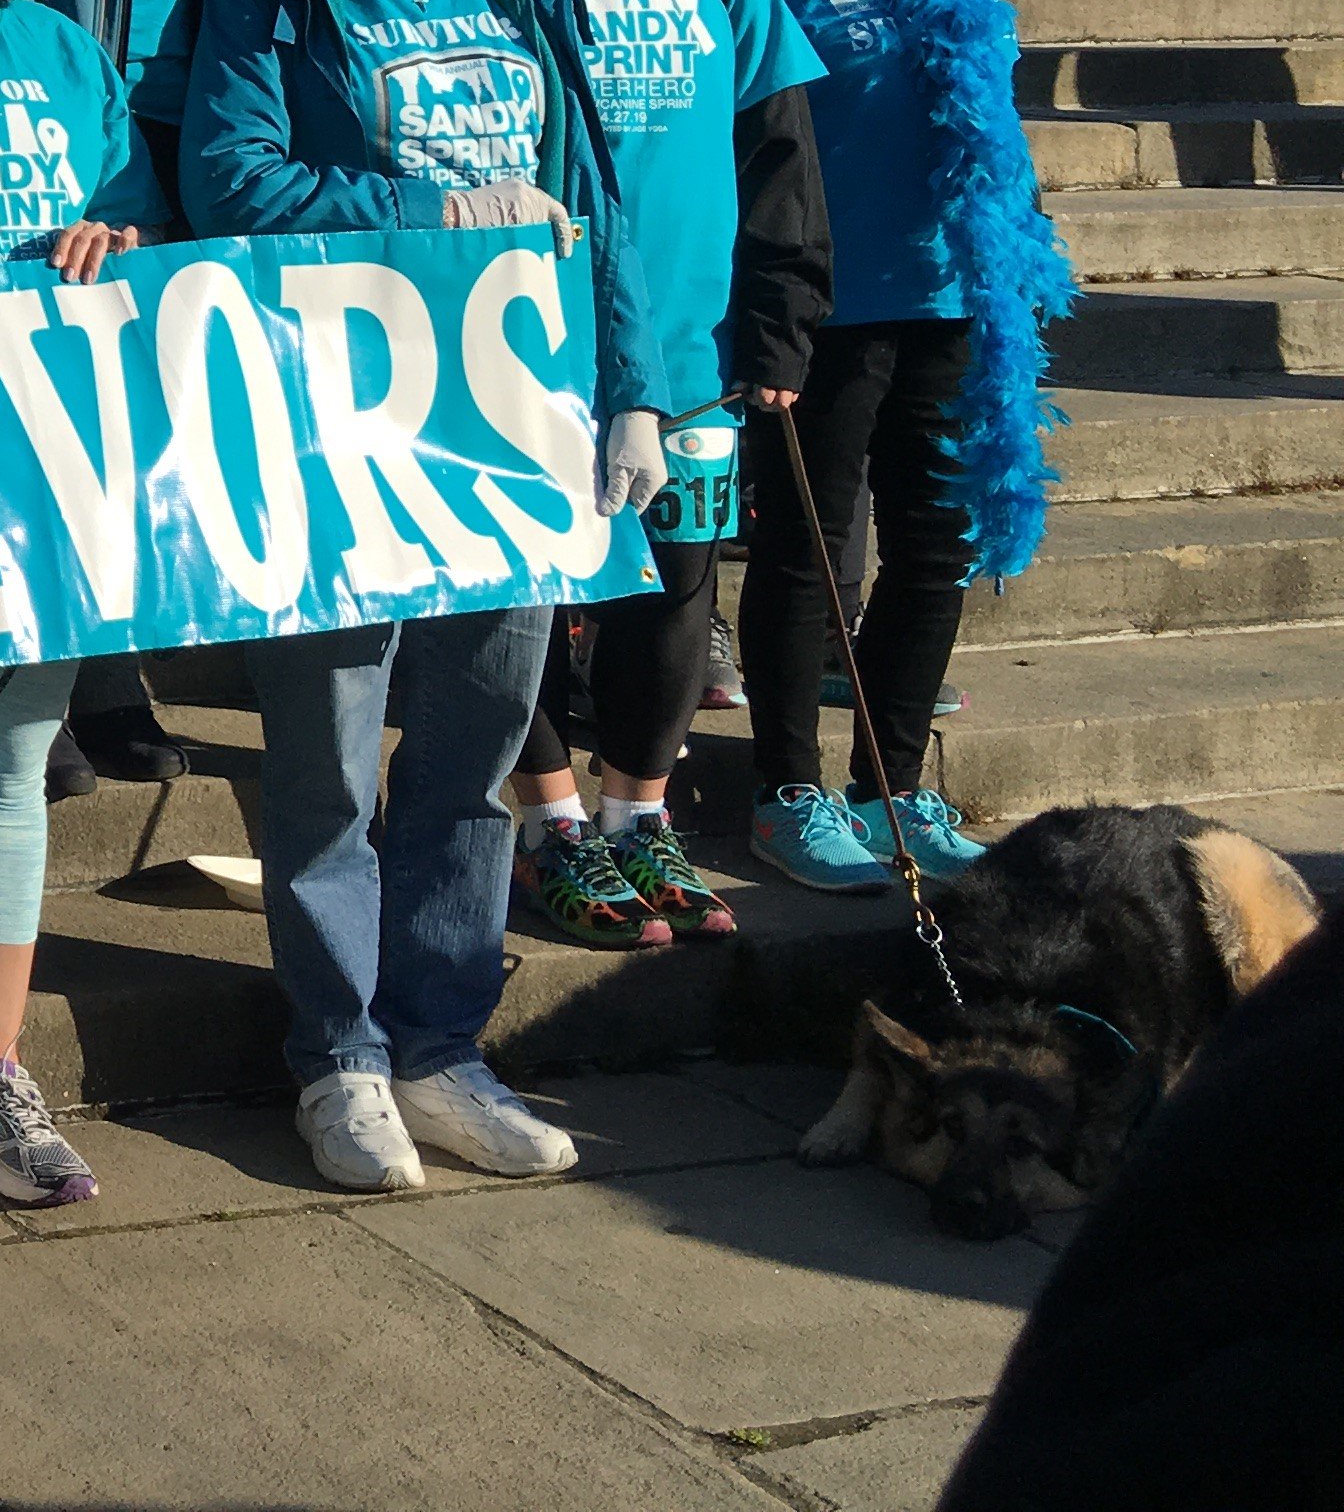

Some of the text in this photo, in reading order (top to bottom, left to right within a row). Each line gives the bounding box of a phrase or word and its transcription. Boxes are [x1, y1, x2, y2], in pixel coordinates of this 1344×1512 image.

[588, 10, 694, 42] ANDY
[583, 43, 698, 75] PRINT
[591, 79, 696, 97] ERHERO
[649, 98, 694, 109] SPRINT
[399, 100, 532, 138] SANDY
[398, 133, 536, 170] SPRINT
